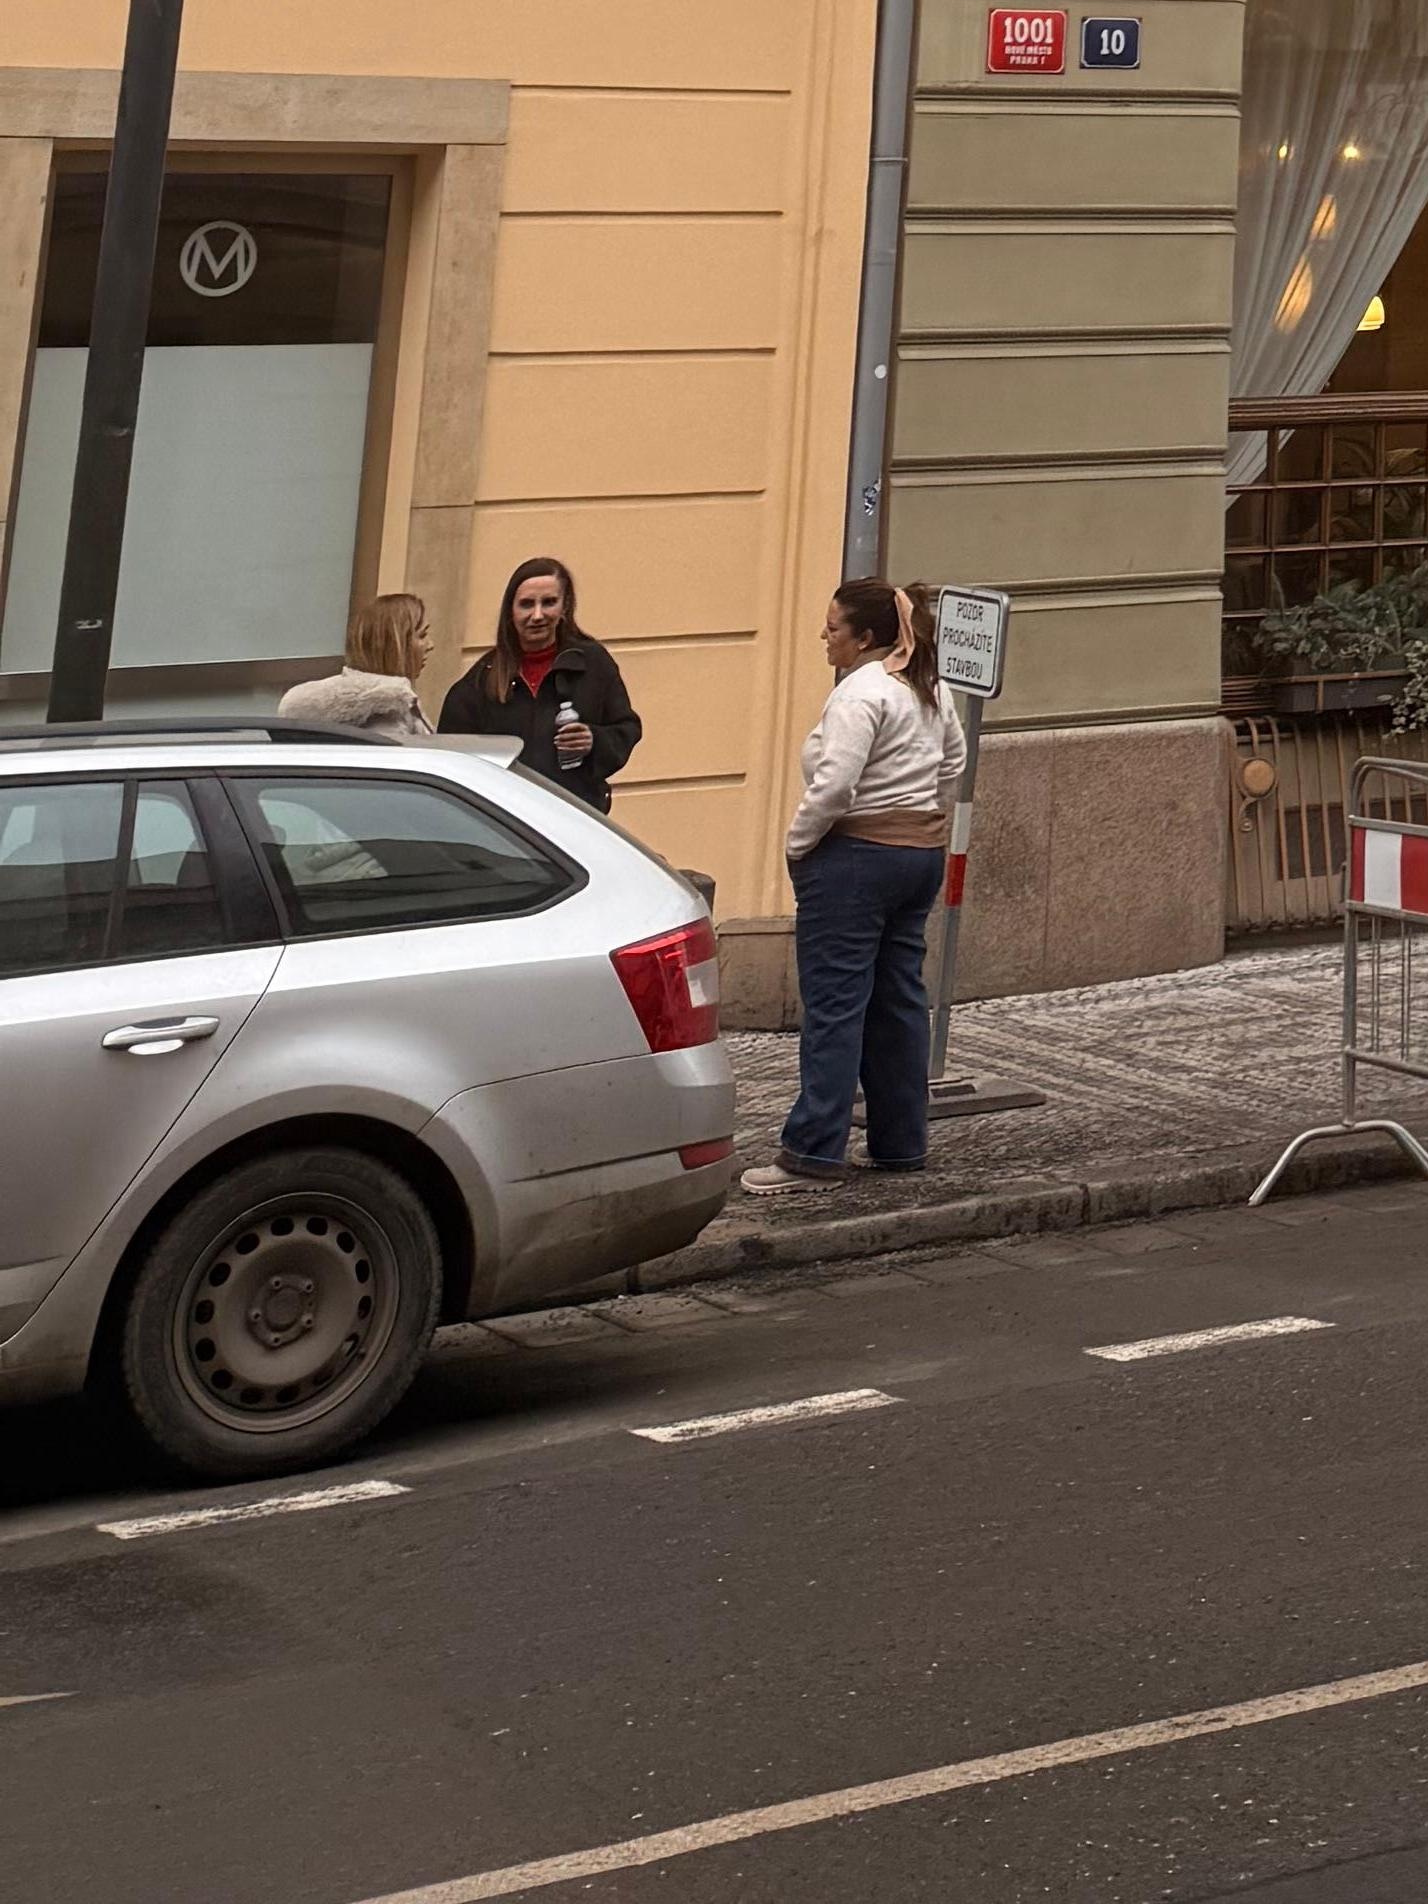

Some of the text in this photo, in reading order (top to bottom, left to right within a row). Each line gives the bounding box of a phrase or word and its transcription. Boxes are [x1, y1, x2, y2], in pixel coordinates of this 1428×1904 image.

[1003, 17, 1054, 44] 1001
[1100, 29, 1125, 55] 10
[956, 601, 984, 622] POZOR
[946, 656, 983, 680] STAVBOU
